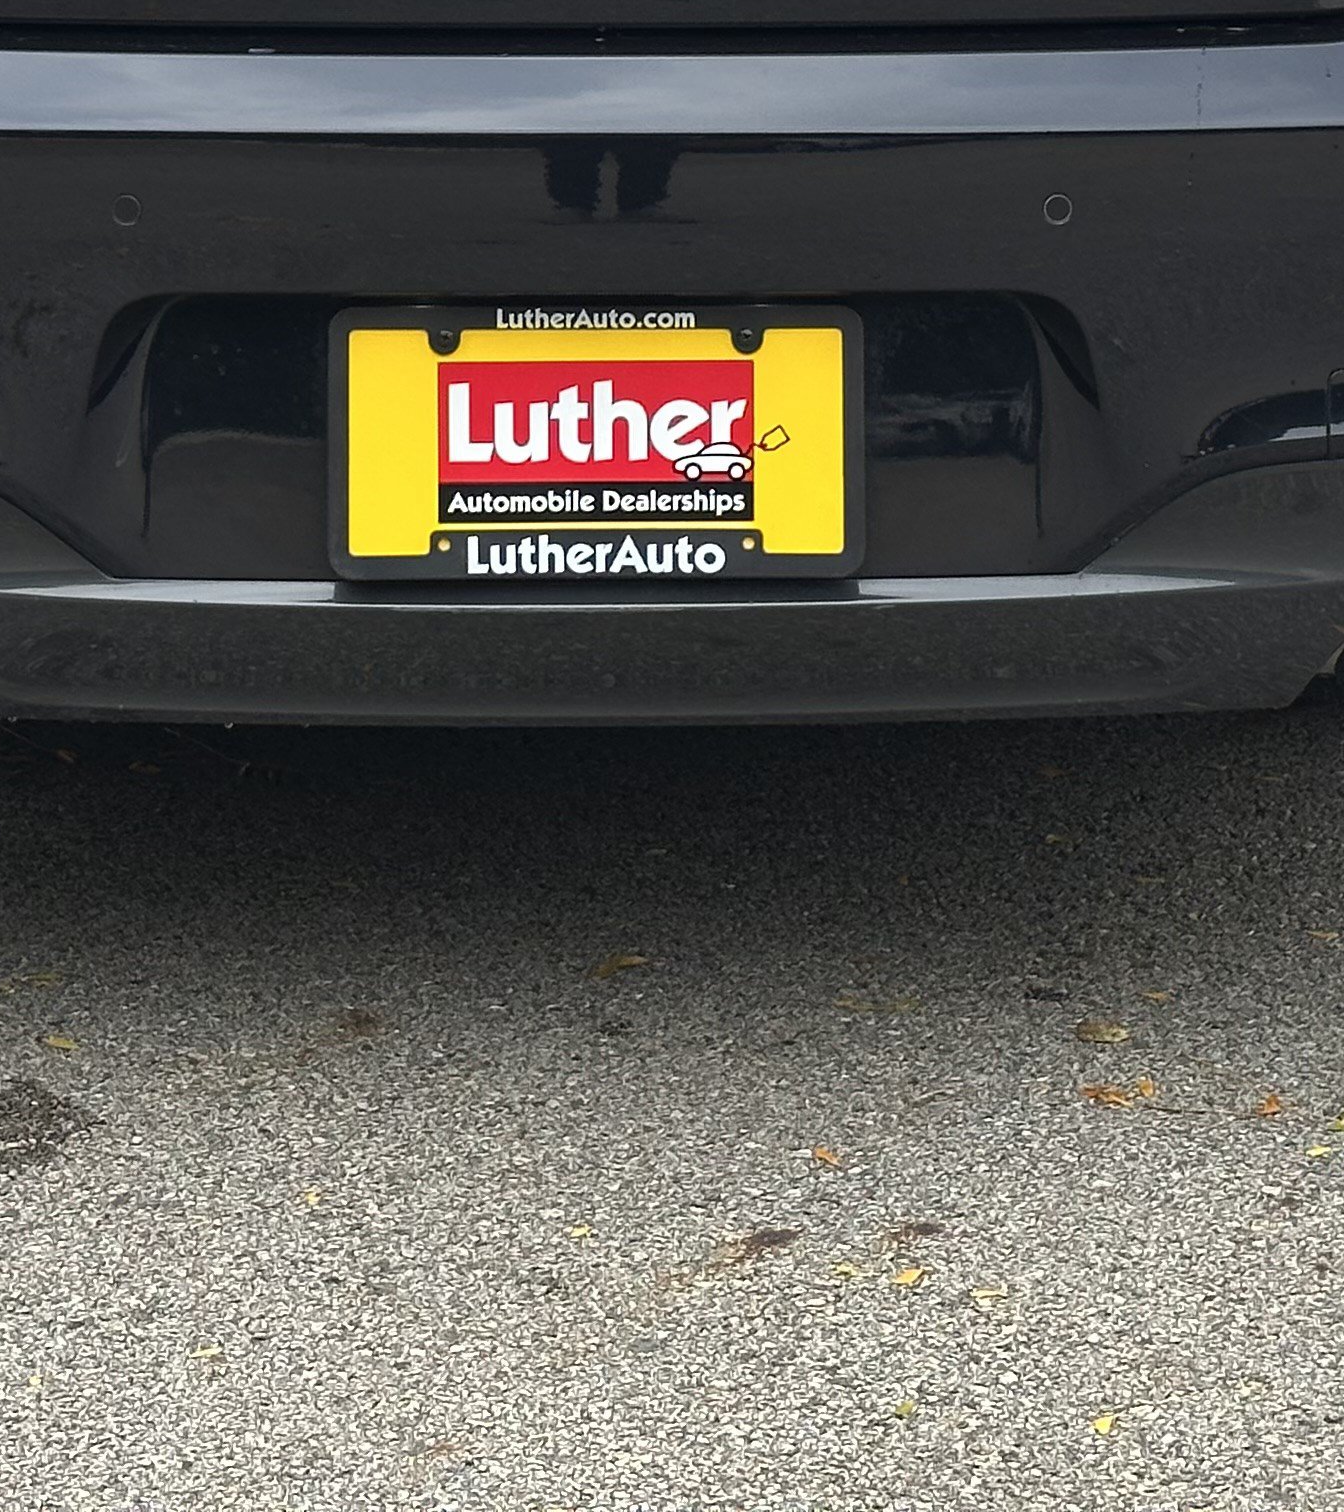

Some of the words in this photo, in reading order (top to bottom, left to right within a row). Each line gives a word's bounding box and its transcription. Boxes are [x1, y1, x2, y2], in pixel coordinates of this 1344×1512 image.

[496, 308, 696, 329] LutherAuto.com
[448, 379, 748, 464] Luther
[448, 489, 595, 513] Automobile
[602, 489, 745, 516] Dealerships
[467, 534, 726, 575] LutherAuto
